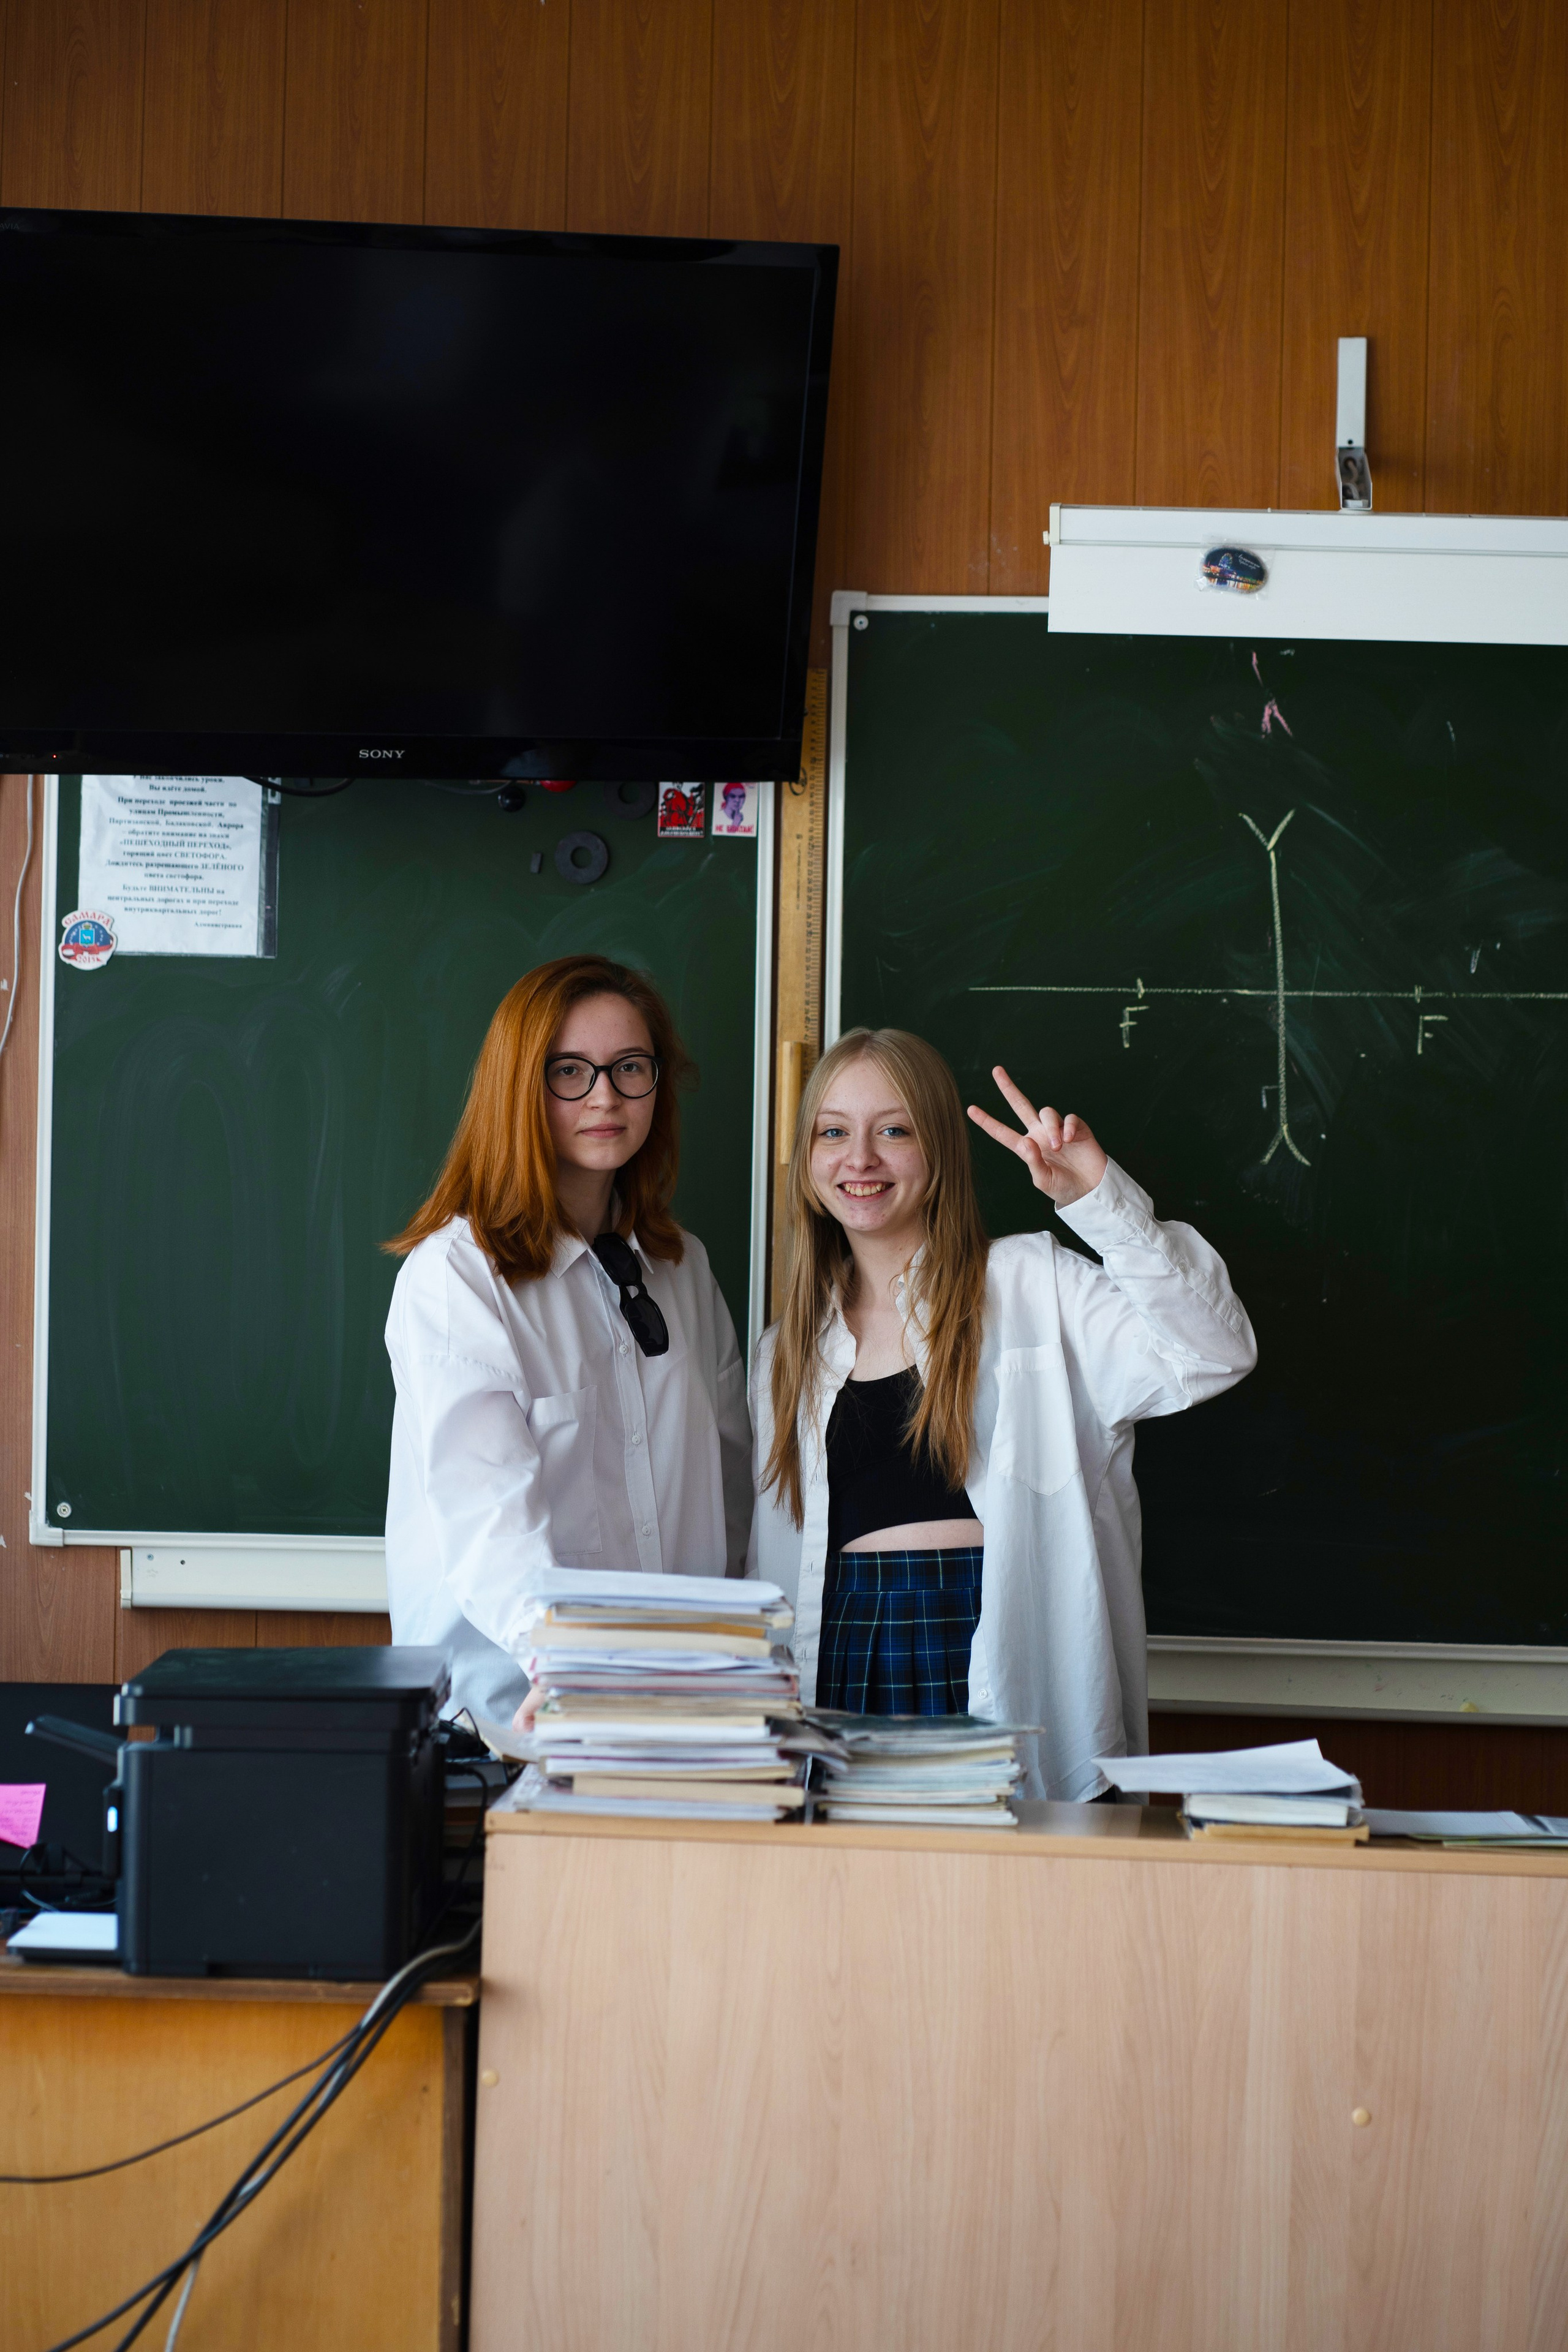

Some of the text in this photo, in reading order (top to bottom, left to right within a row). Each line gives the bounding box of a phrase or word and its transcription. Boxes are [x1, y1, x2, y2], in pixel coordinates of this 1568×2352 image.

[359, 749, 404, 758] SONY
[118, 796, 133, 805] При
[149, 885, 214, 894] ВНИМАТЕЛЬНЫ
[64, 911, 110, 927] САМАРА
